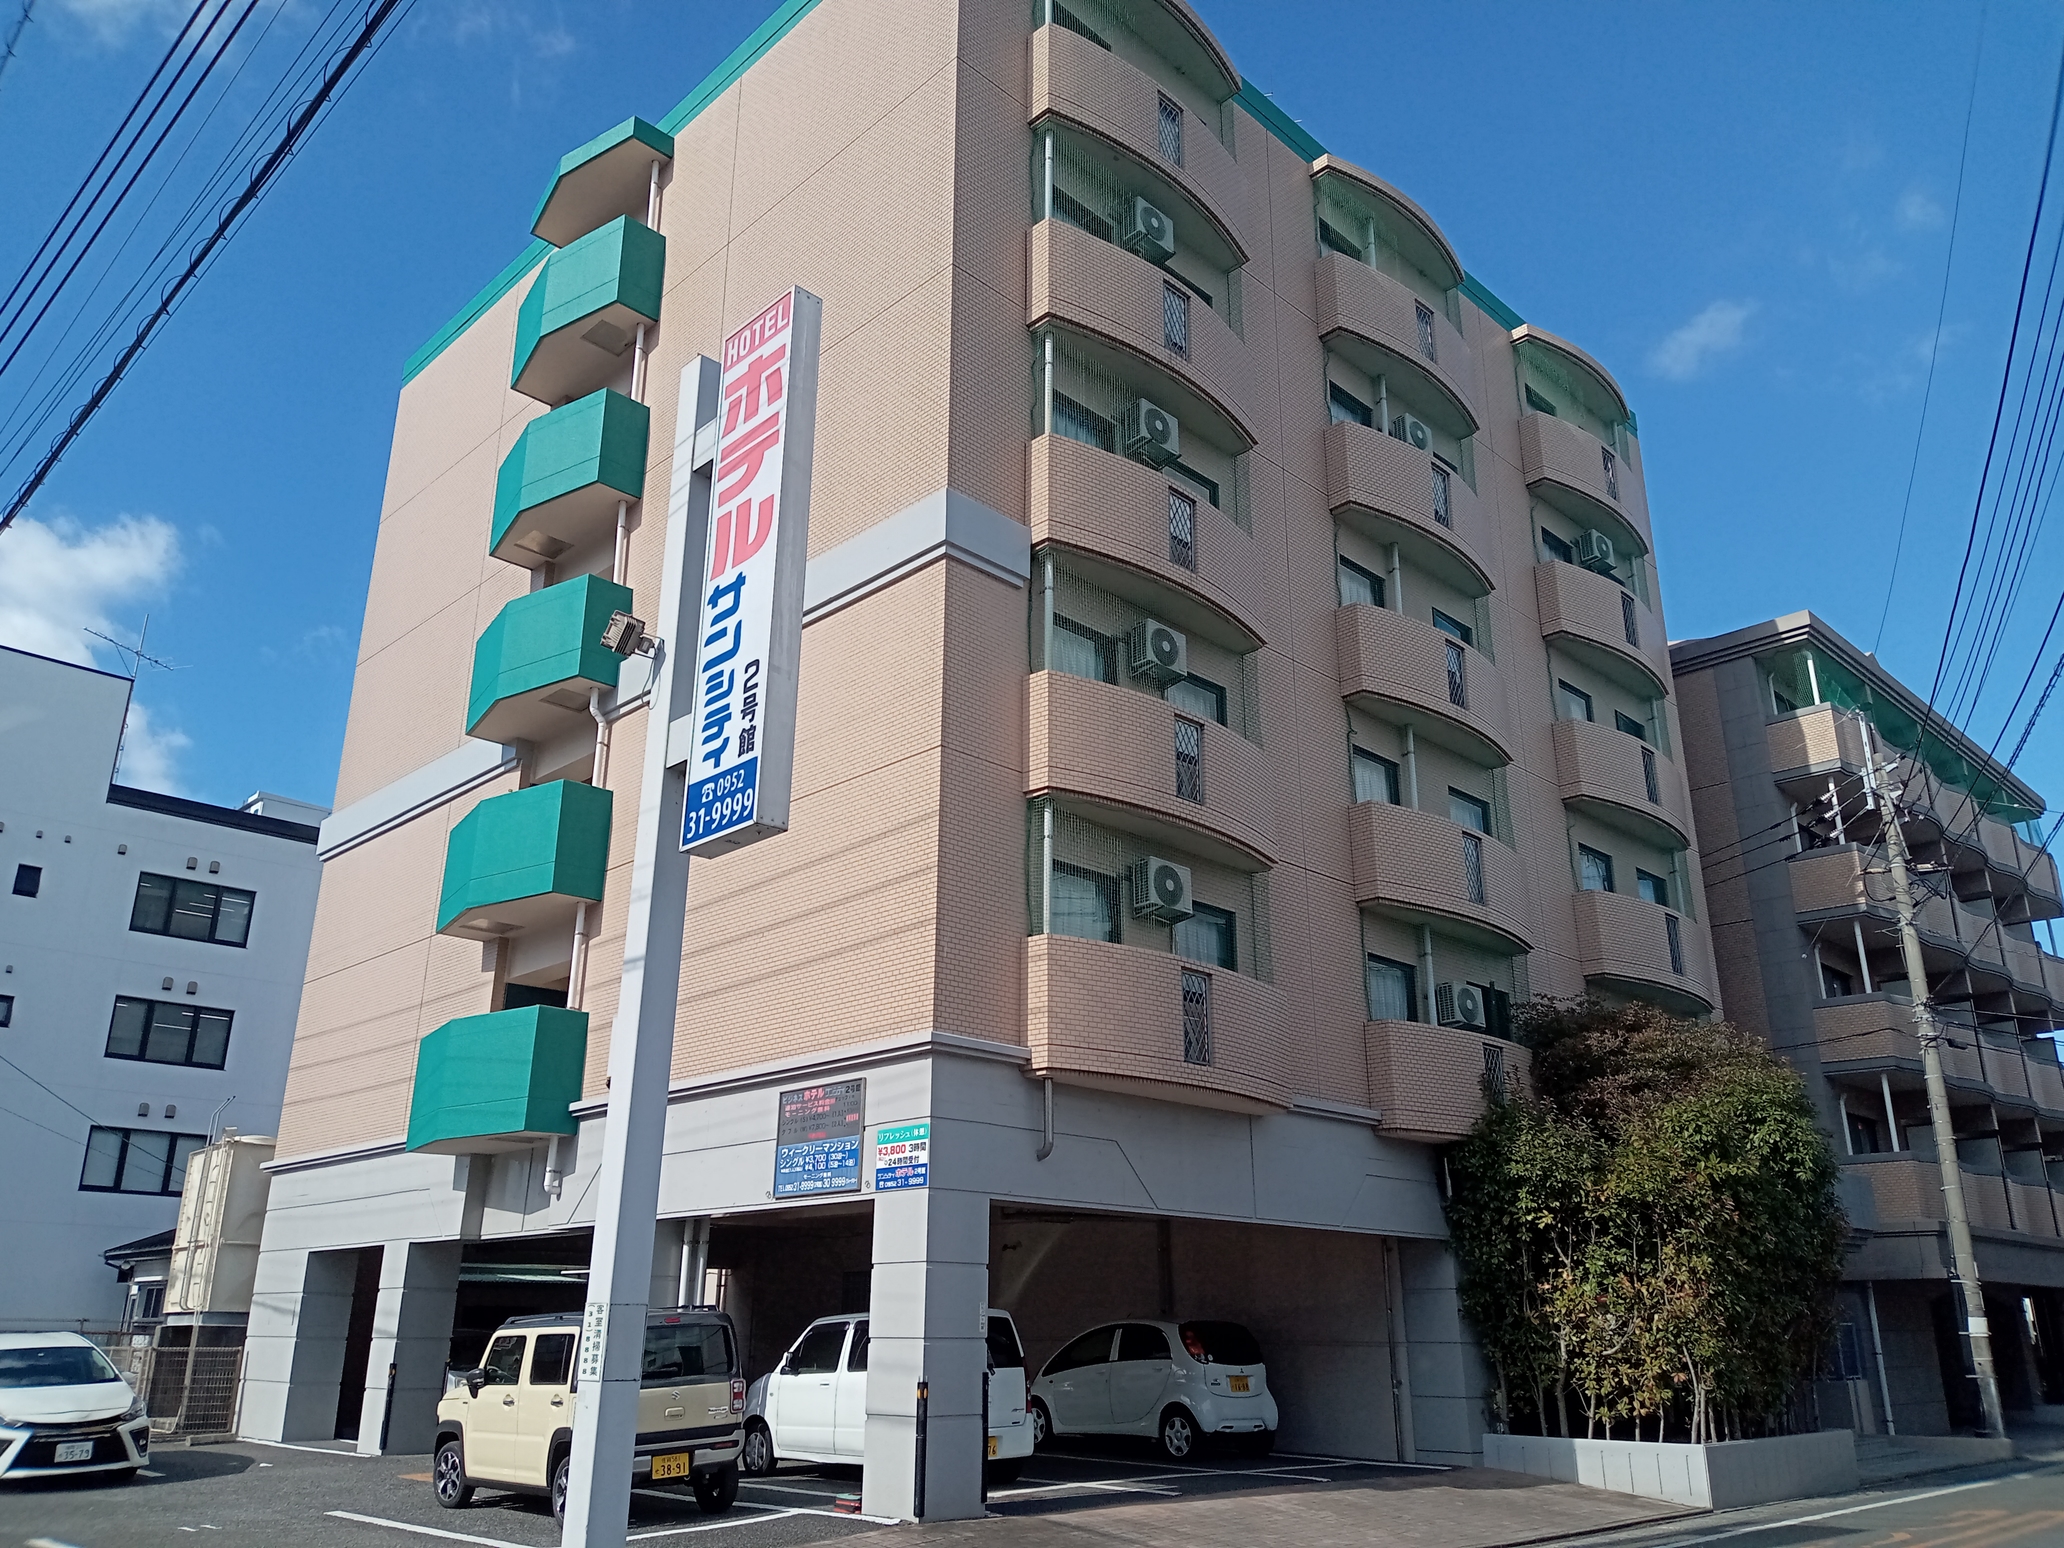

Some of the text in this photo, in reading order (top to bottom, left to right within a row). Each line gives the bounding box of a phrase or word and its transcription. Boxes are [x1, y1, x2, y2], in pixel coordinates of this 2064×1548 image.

[726, 303, 789, 367] HOTEL
[709, 343, 787, 582] ホテル
[737, 658, 760, 758] 2号館
[717, 769, 745, 797] 0952
[686, 788, 754, 839] 31-9999
[803, 1086, 825, 1101] ホテル
[781, 1140, 859, 1158] ウィークリーマンション
[878, 1141, 927, 1156] ¥3,800 3時間
[779, 1157, 804, 1168] シングル
[895, 1166, 914, 1177] ホテル
[589, 1304, 605, 1377] 客室清掃募集
[660, 1462, 686, 1476] 38-91
